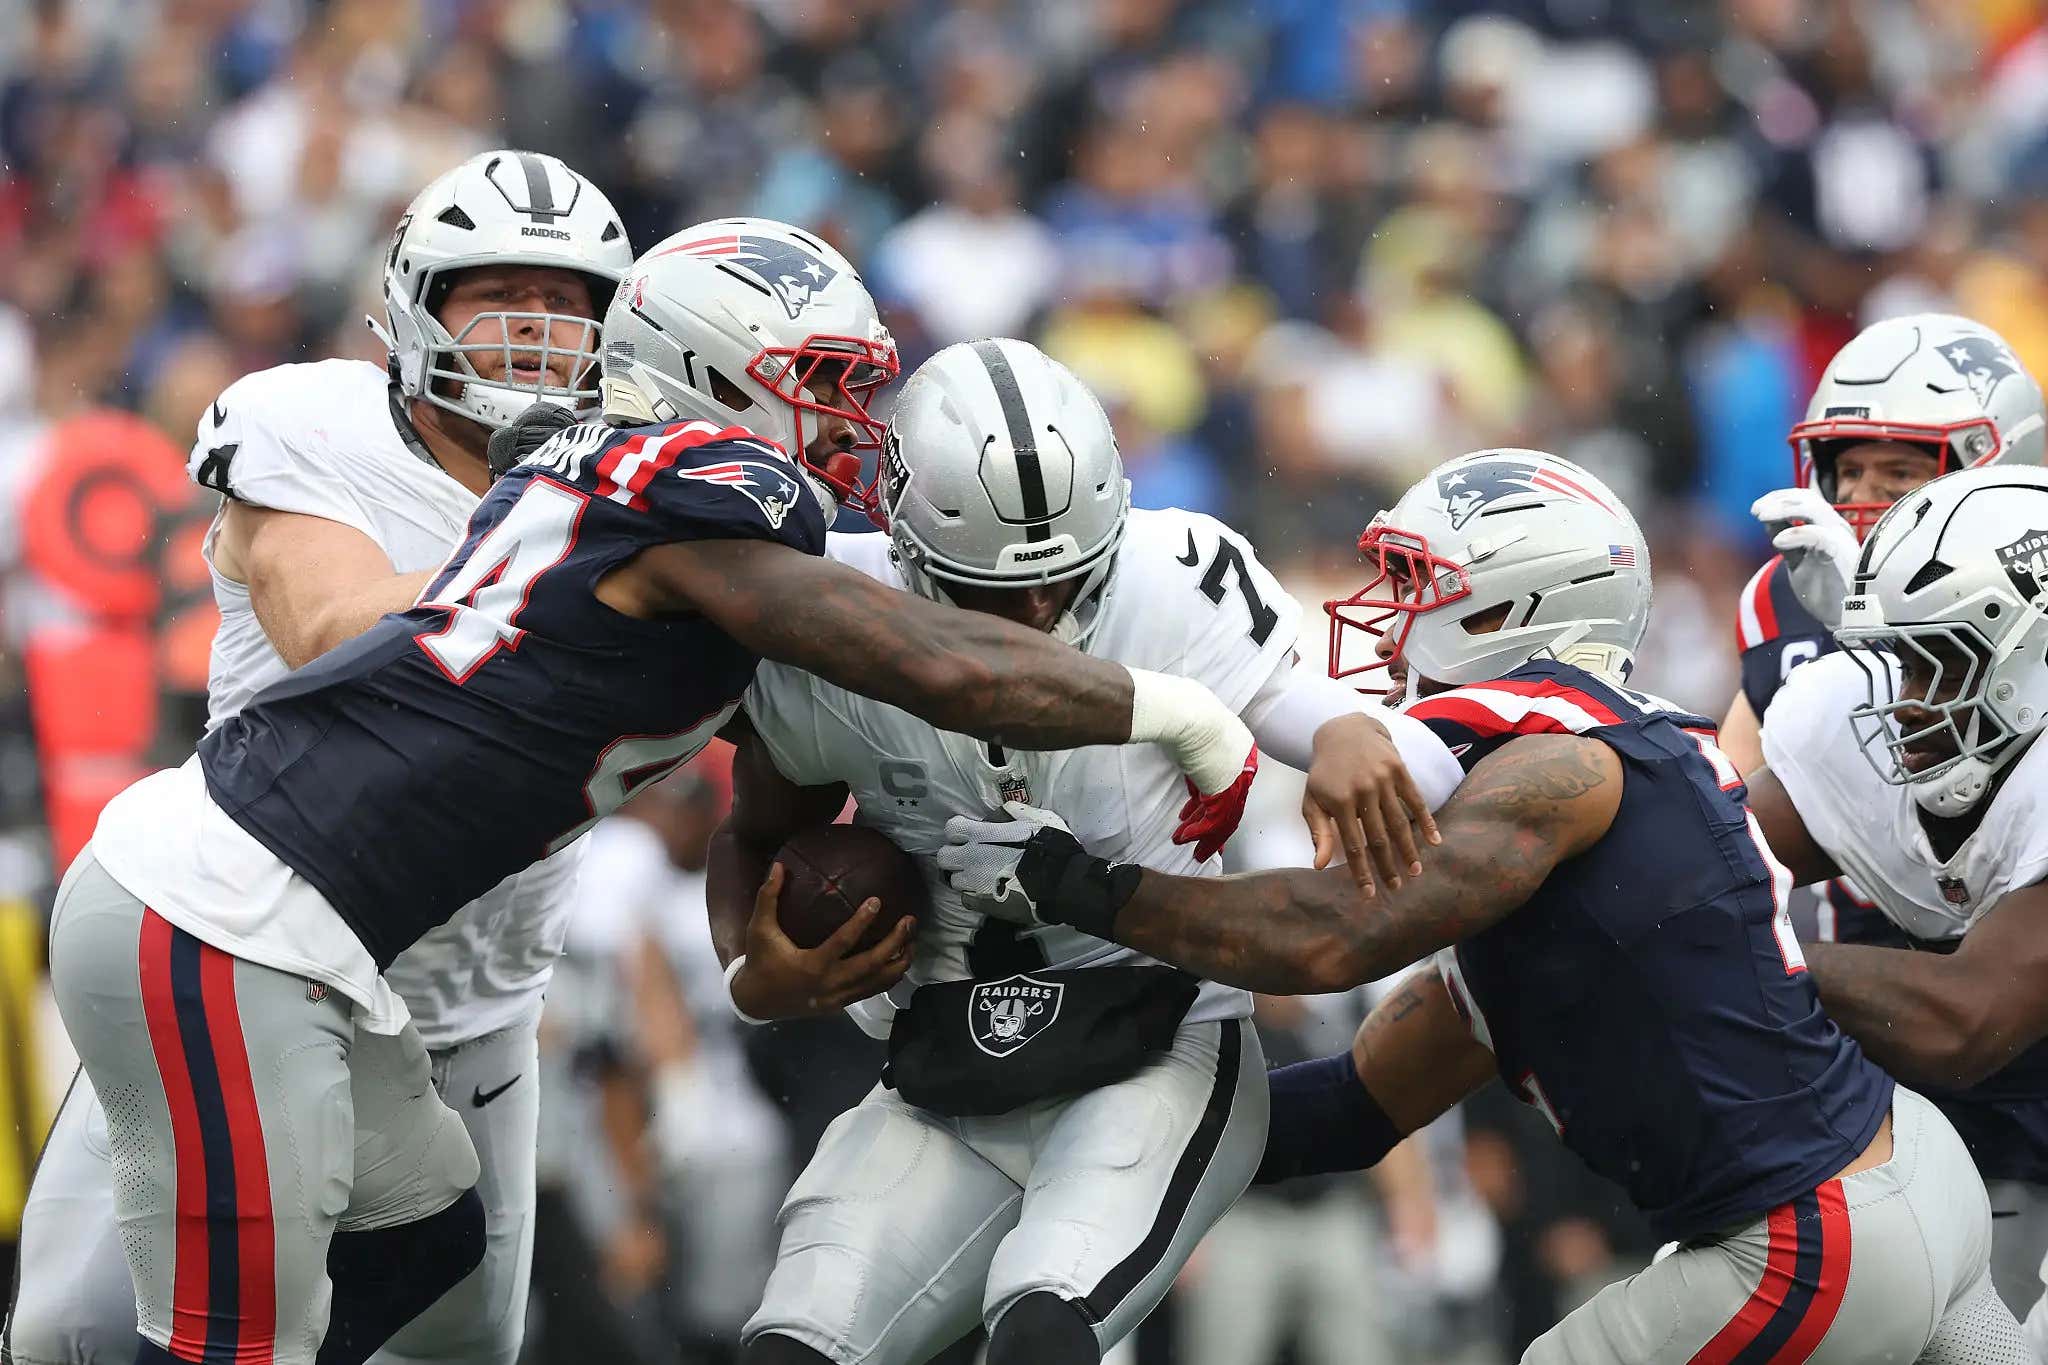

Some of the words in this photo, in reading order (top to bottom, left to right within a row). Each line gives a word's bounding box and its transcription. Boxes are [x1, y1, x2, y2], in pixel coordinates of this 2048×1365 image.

[521, 227, 571, 241] RAIDERS
[1013, 544, 1065, 562] RAIDERS
[411, 473, 592, 687] 4
[1198, 535, 1280, 648] 7
[878, 760, 929, 798] C
[1004, 789, 1028, 804] NFL
[980, 986, 1053, 1000] RAIDERS
